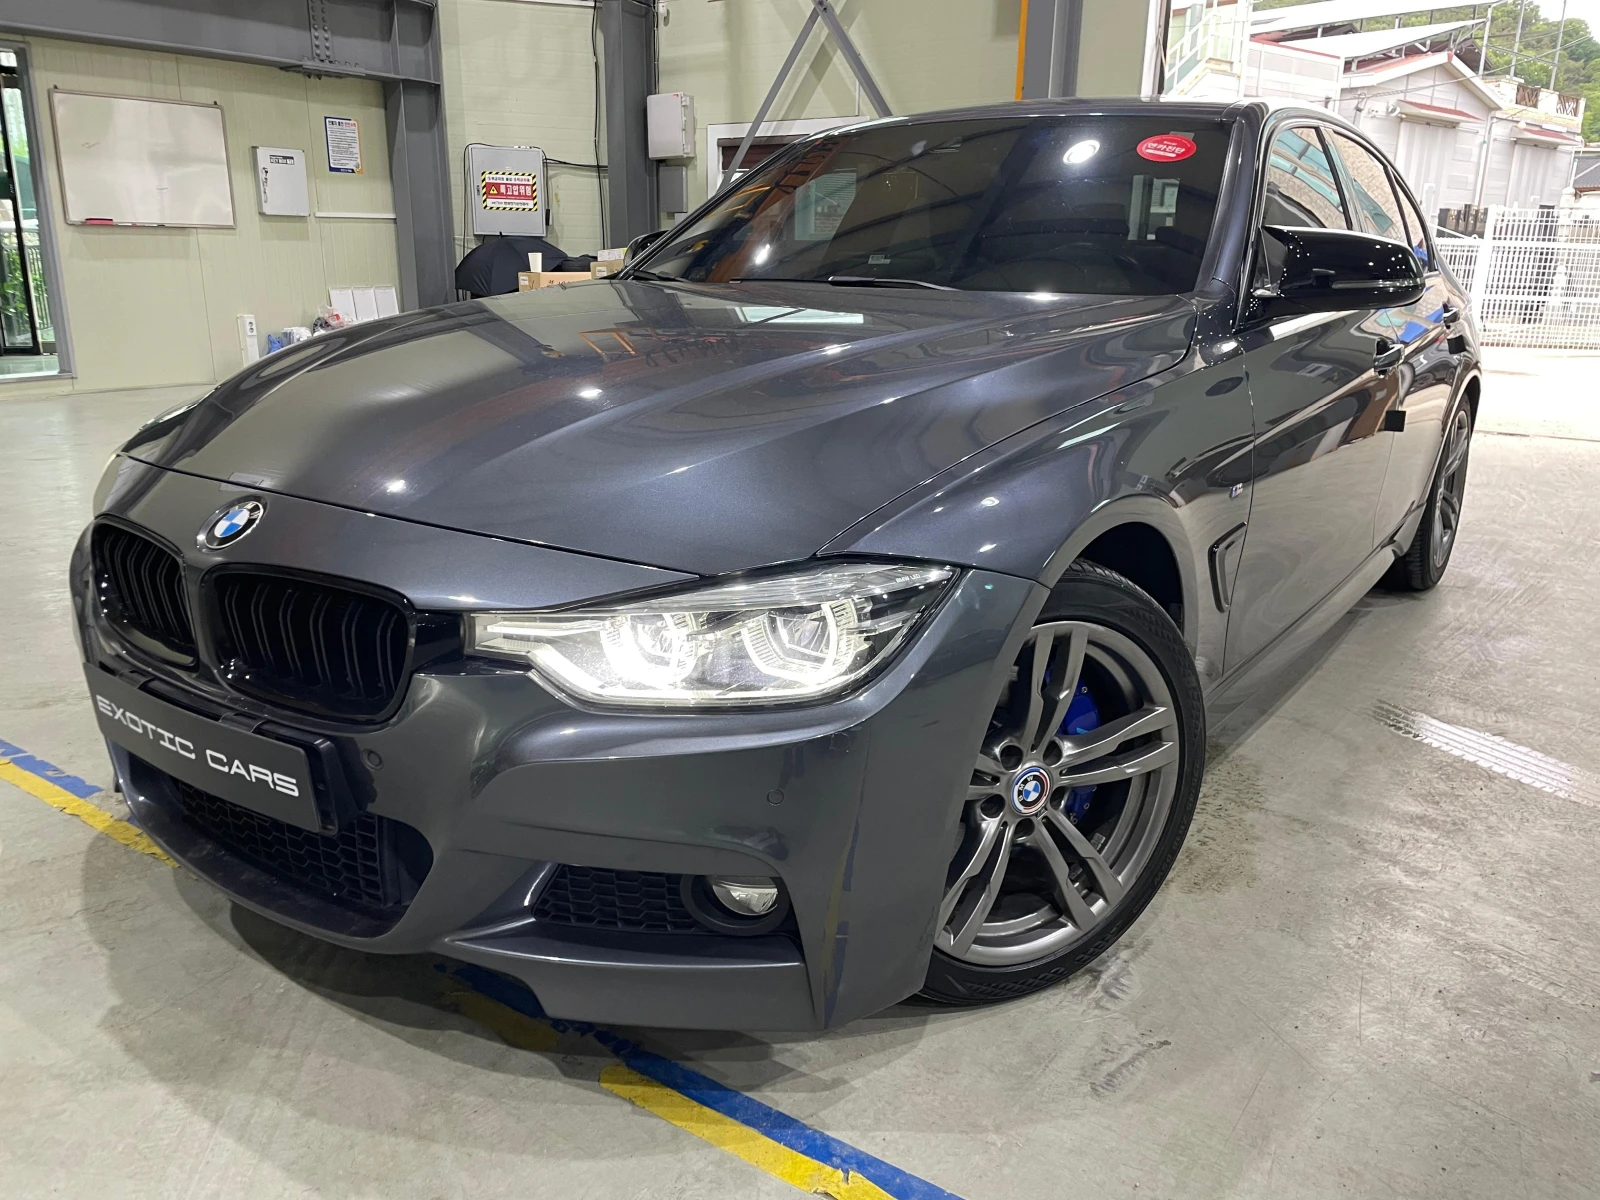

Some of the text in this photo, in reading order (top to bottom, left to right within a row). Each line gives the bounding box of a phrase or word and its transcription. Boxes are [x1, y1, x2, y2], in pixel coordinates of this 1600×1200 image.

[1147, 142, 1186, 154] 엔카진단
[500, 184, 532, 196] 특고압위험
[95, 694, 299, 797] EXOTIC CARS
[1018, 775, 1034, 802] BMW
